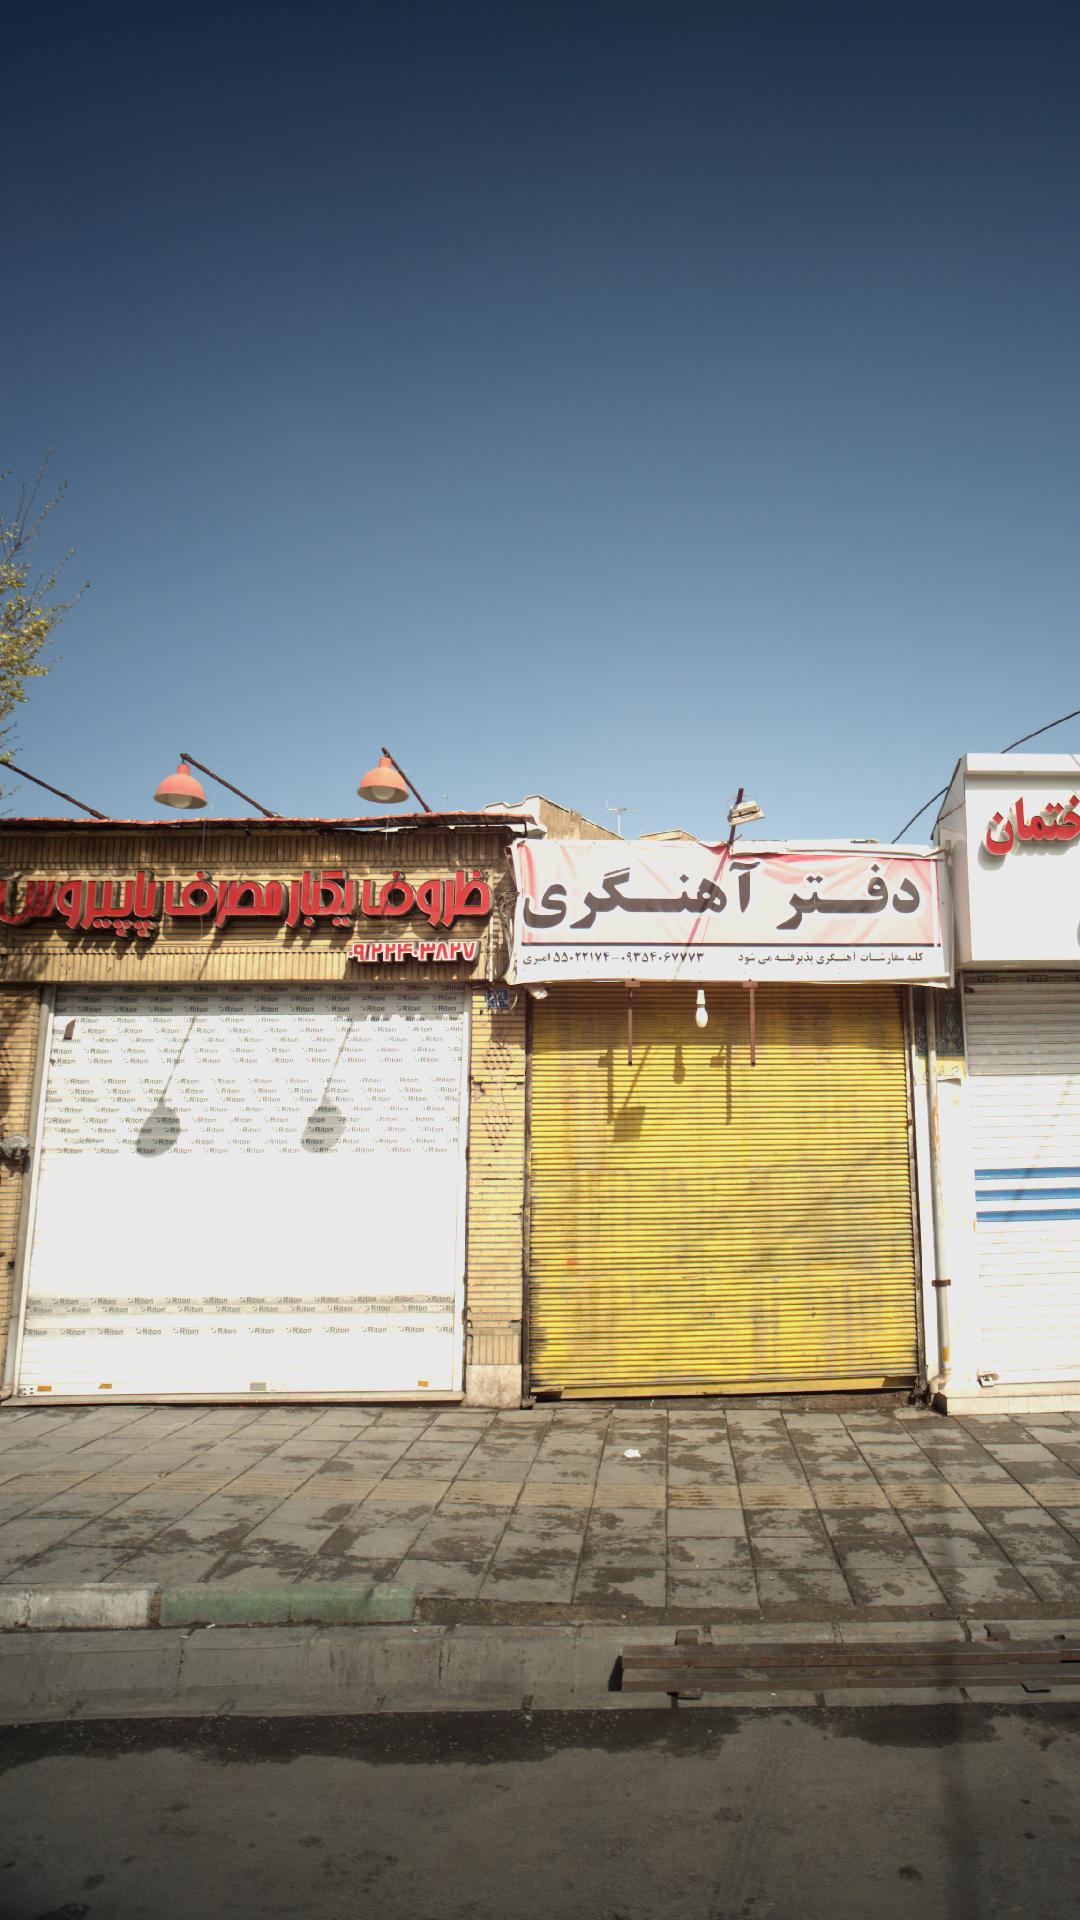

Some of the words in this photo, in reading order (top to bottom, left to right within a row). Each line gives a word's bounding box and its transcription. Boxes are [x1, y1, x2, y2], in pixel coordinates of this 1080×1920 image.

[362, 870, 491, 927] ظروف
[523, 861, 760, 929] آهنگری
[776, 863, 920, 929] دفتر
[0, 871, 156, 937] پاپیروس
[738, 952, 756, 965] شود
[758, 956, 773, 965] می
[775, 952, 814, 965] پذیرفته
[816, 952, 856, 965] آهنگری
[860, 952, 905, 965] سفارشات
[66, 1328, 85, 1336] Riton
[180, 1327, 199, 1335] Riton
[330, 1326, 349, 1334] Riton
